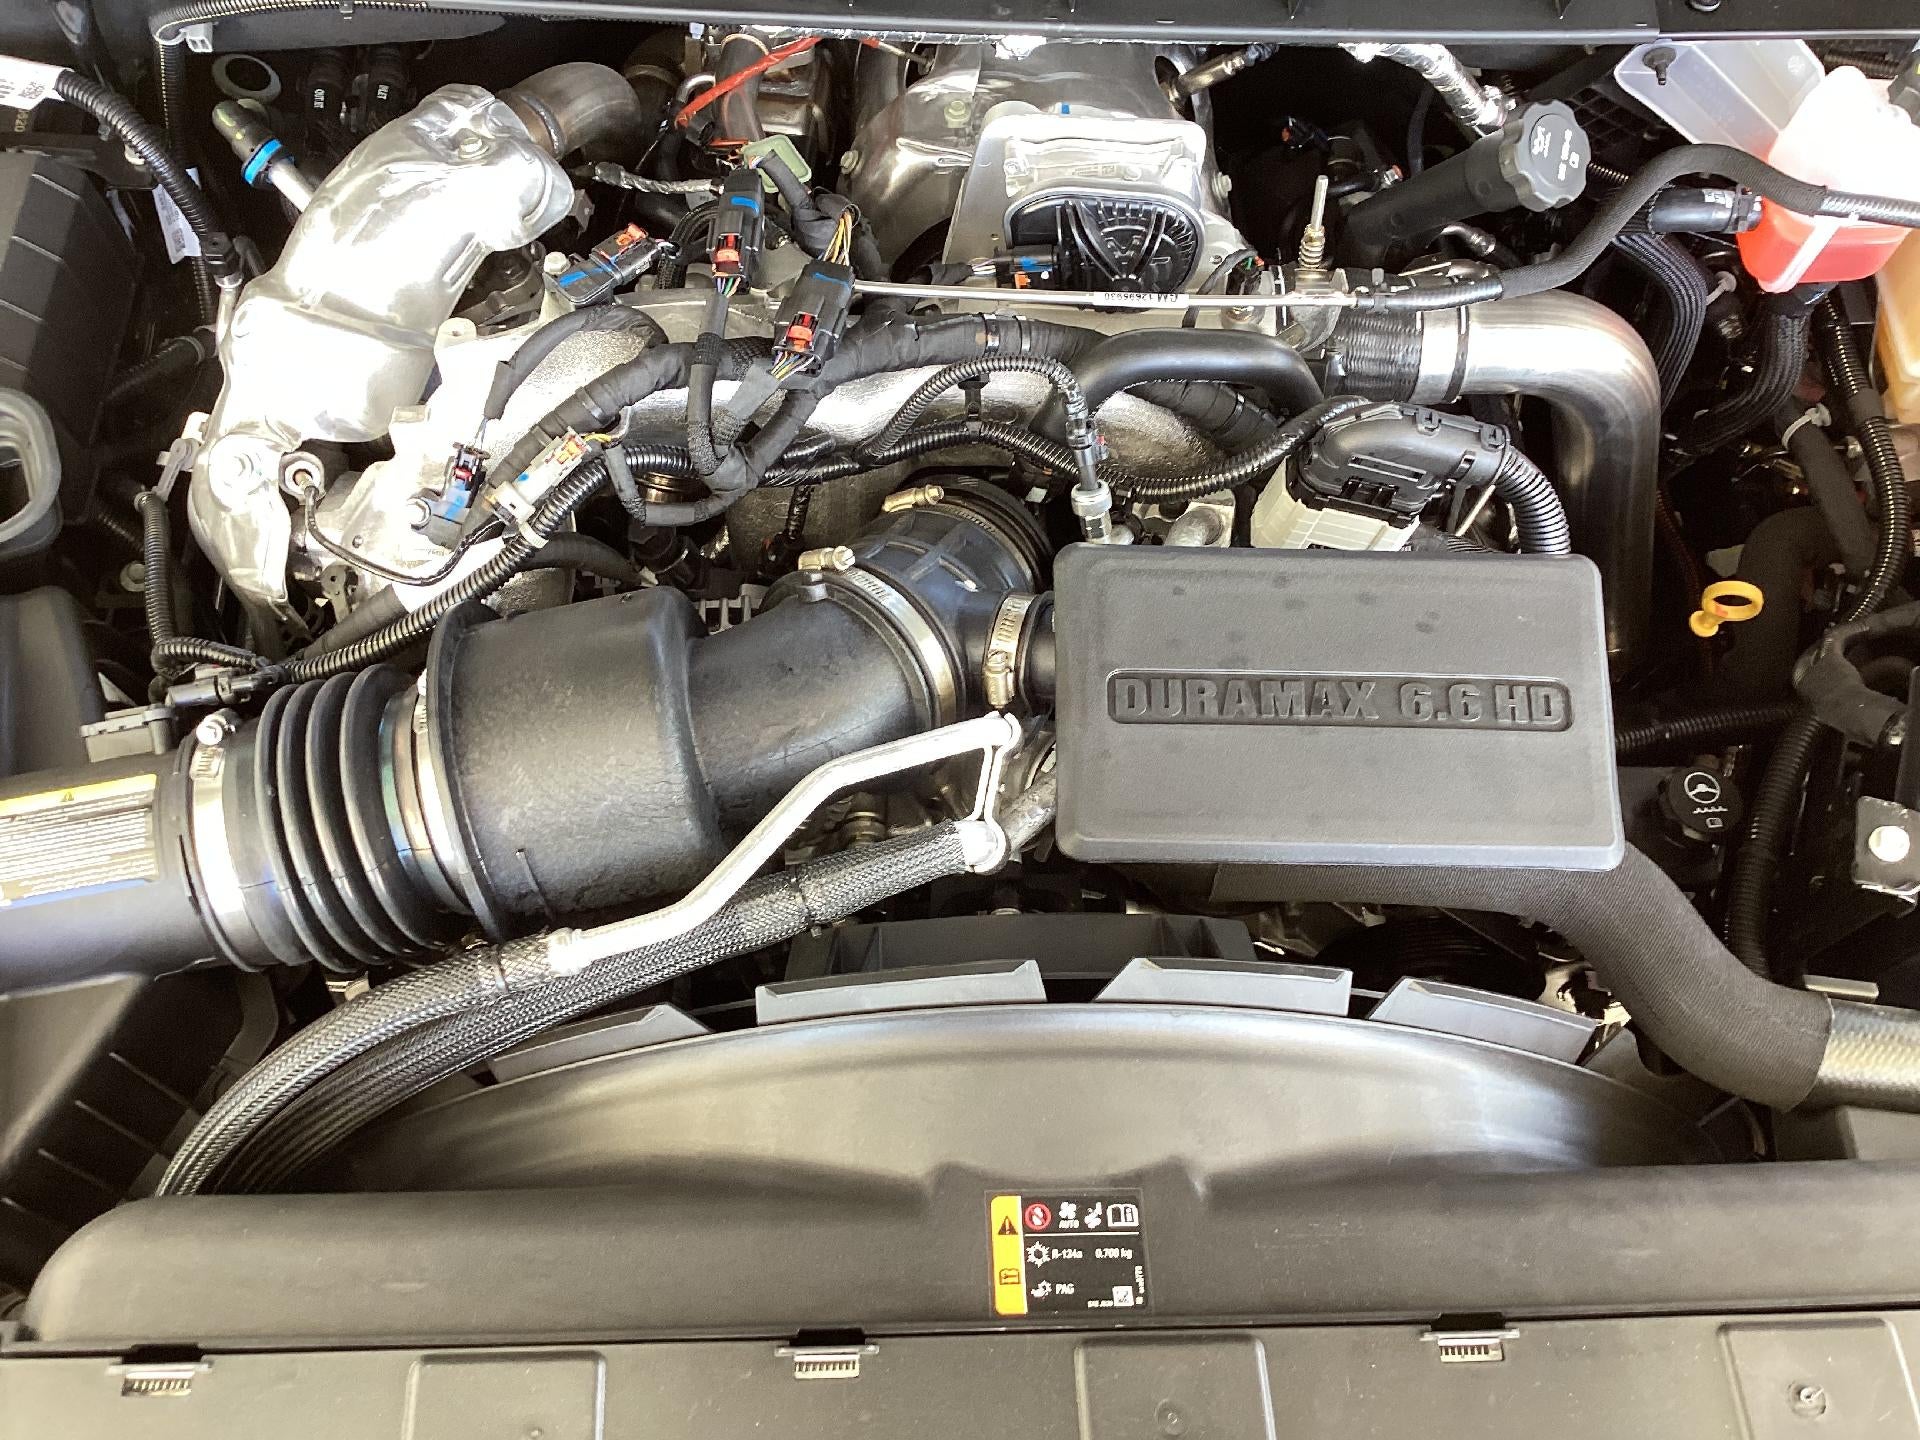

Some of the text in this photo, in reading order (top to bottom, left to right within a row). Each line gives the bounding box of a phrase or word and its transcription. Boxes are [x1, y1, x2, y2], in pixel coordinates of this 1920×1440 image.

[1157, 293, 1178, 303] GM
[1115, 678, 1564, 726] DURAMAX 6.6 HD
[1058, 1219, 1080, 1229] AUTO
[1051, 1248, 1083, 1259] R-134a
[1121, 1247, 1133, 1260] kg
[1055, 1283, 1075, 1295] PAG
